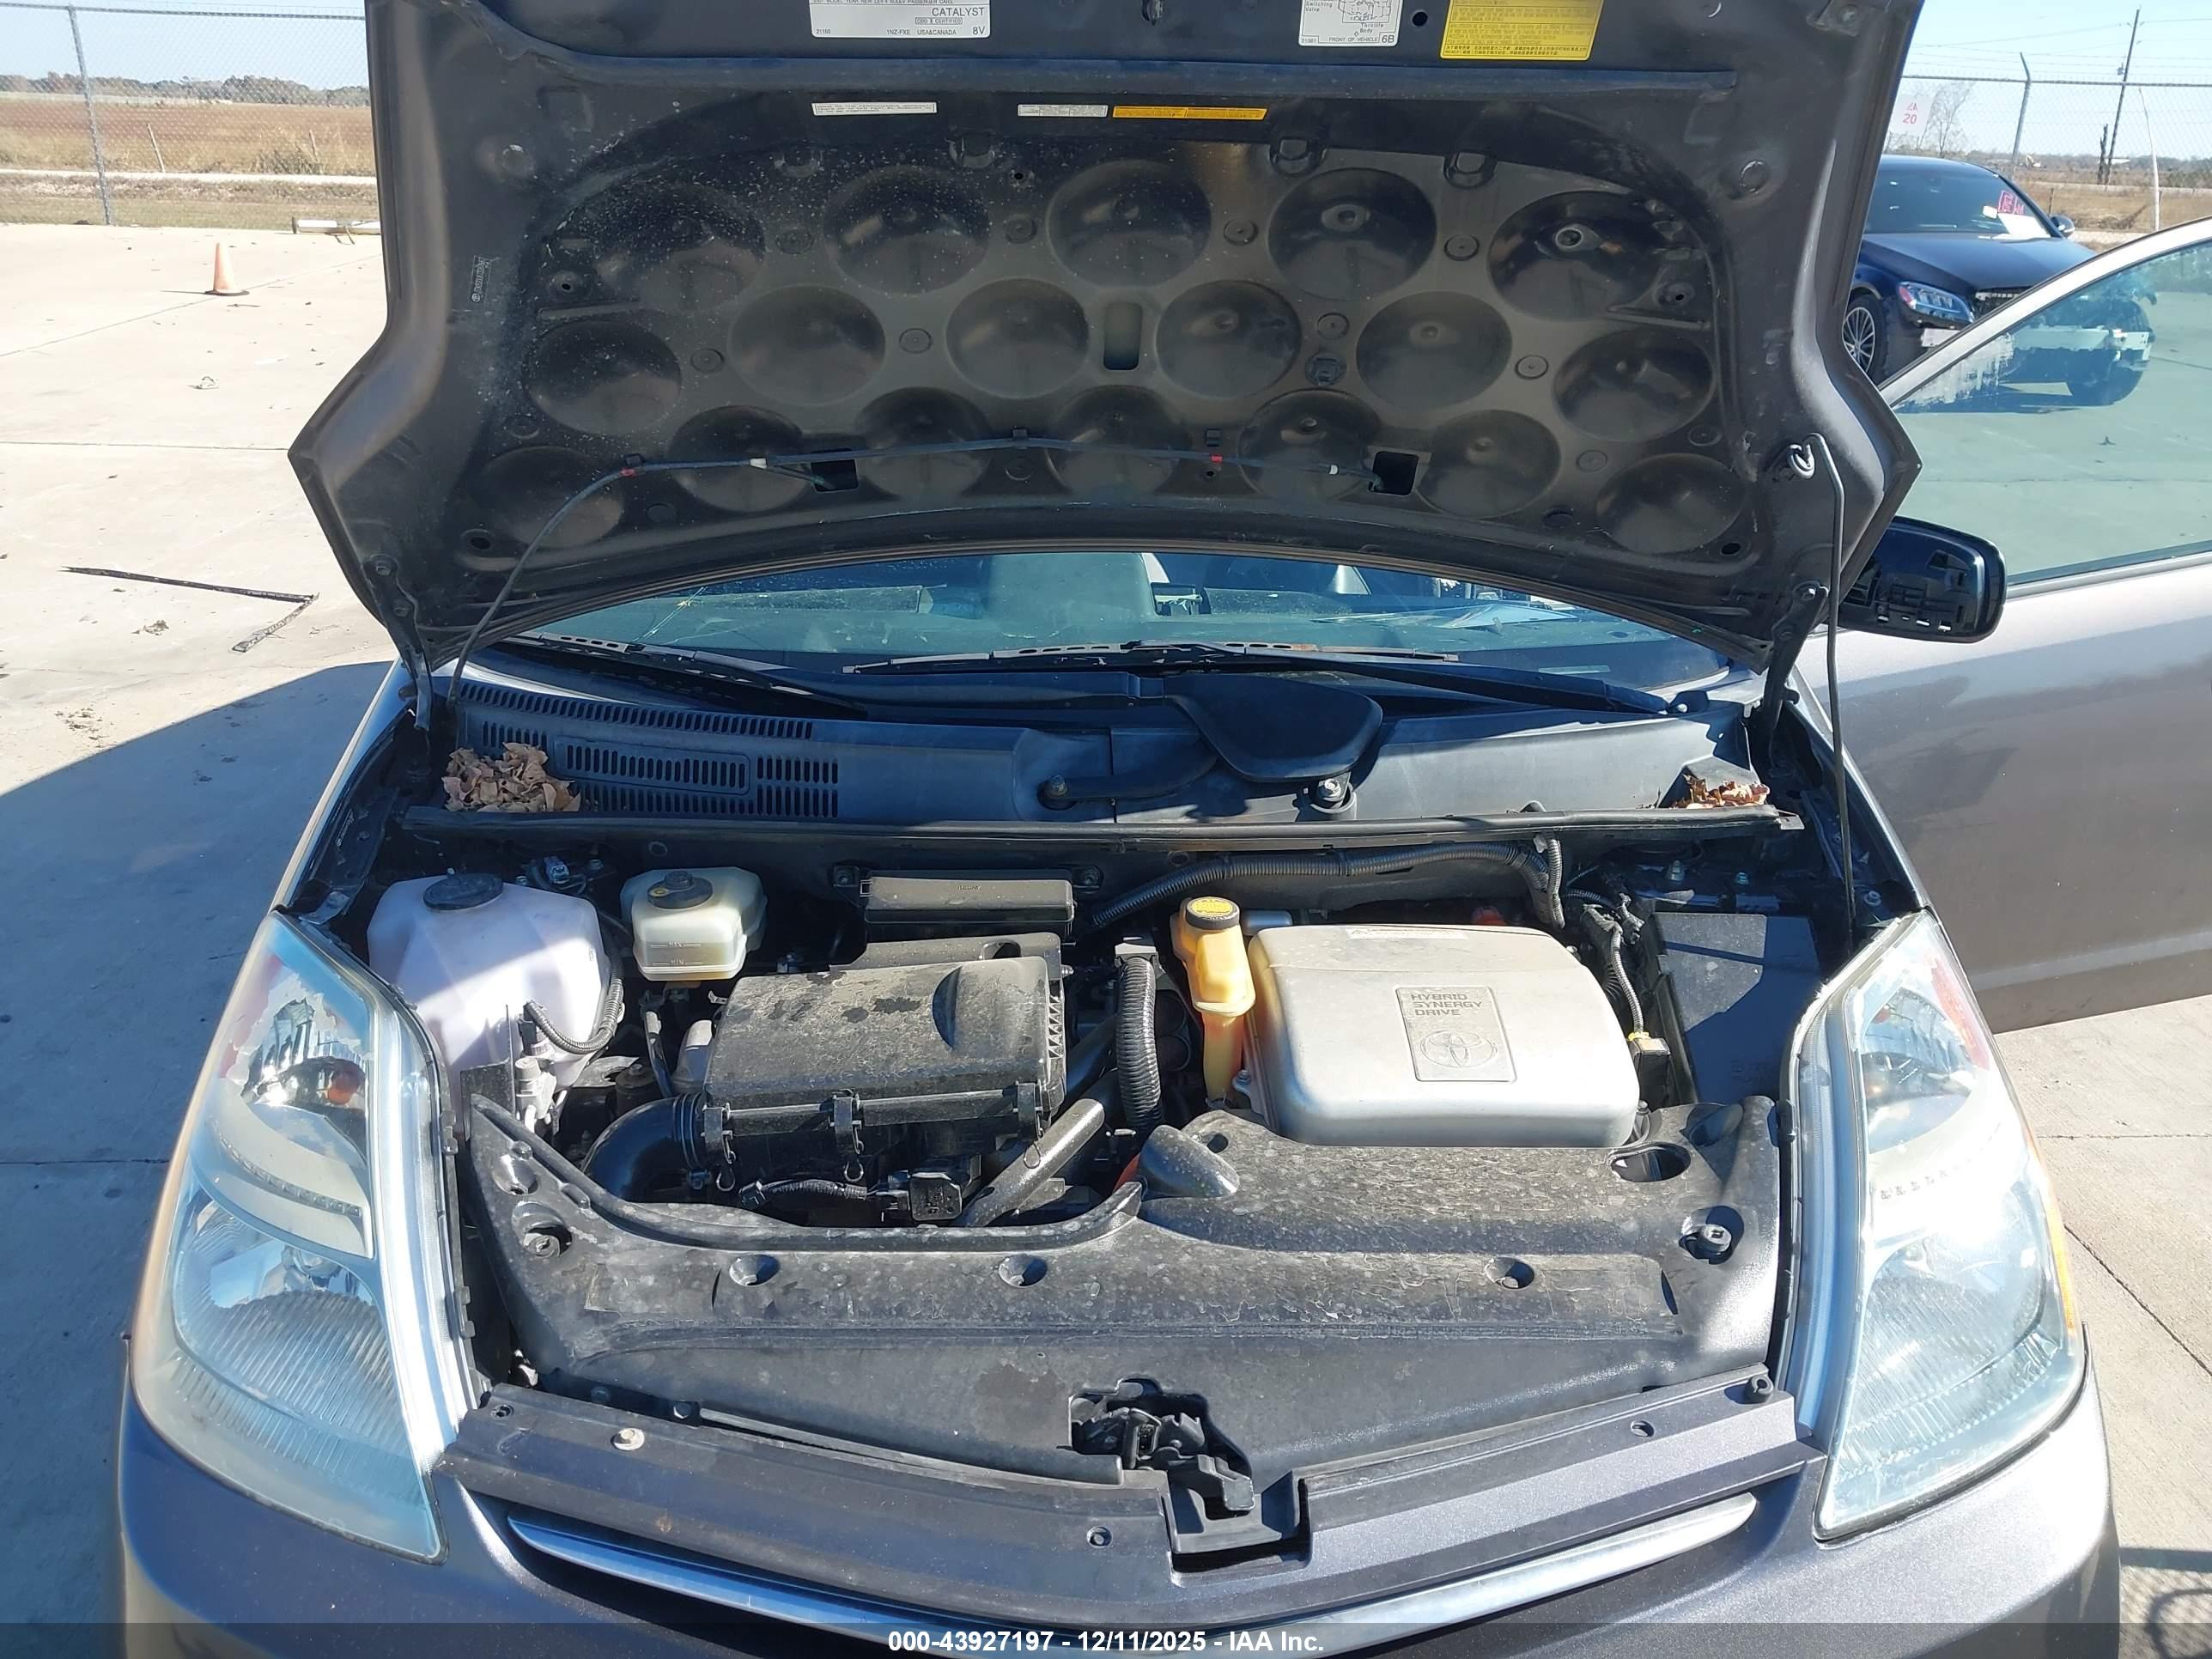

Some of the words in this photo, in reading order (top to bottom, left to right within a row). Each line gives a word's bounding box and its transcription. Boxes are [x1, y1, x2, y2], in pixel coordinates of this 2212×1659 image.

[932, 7, 985, 16] CATALYST
[972, 27, 985, 35] 8V
[1381, 34, 1395, 44] 6B
[1902, 113, 1917, 125] 20
